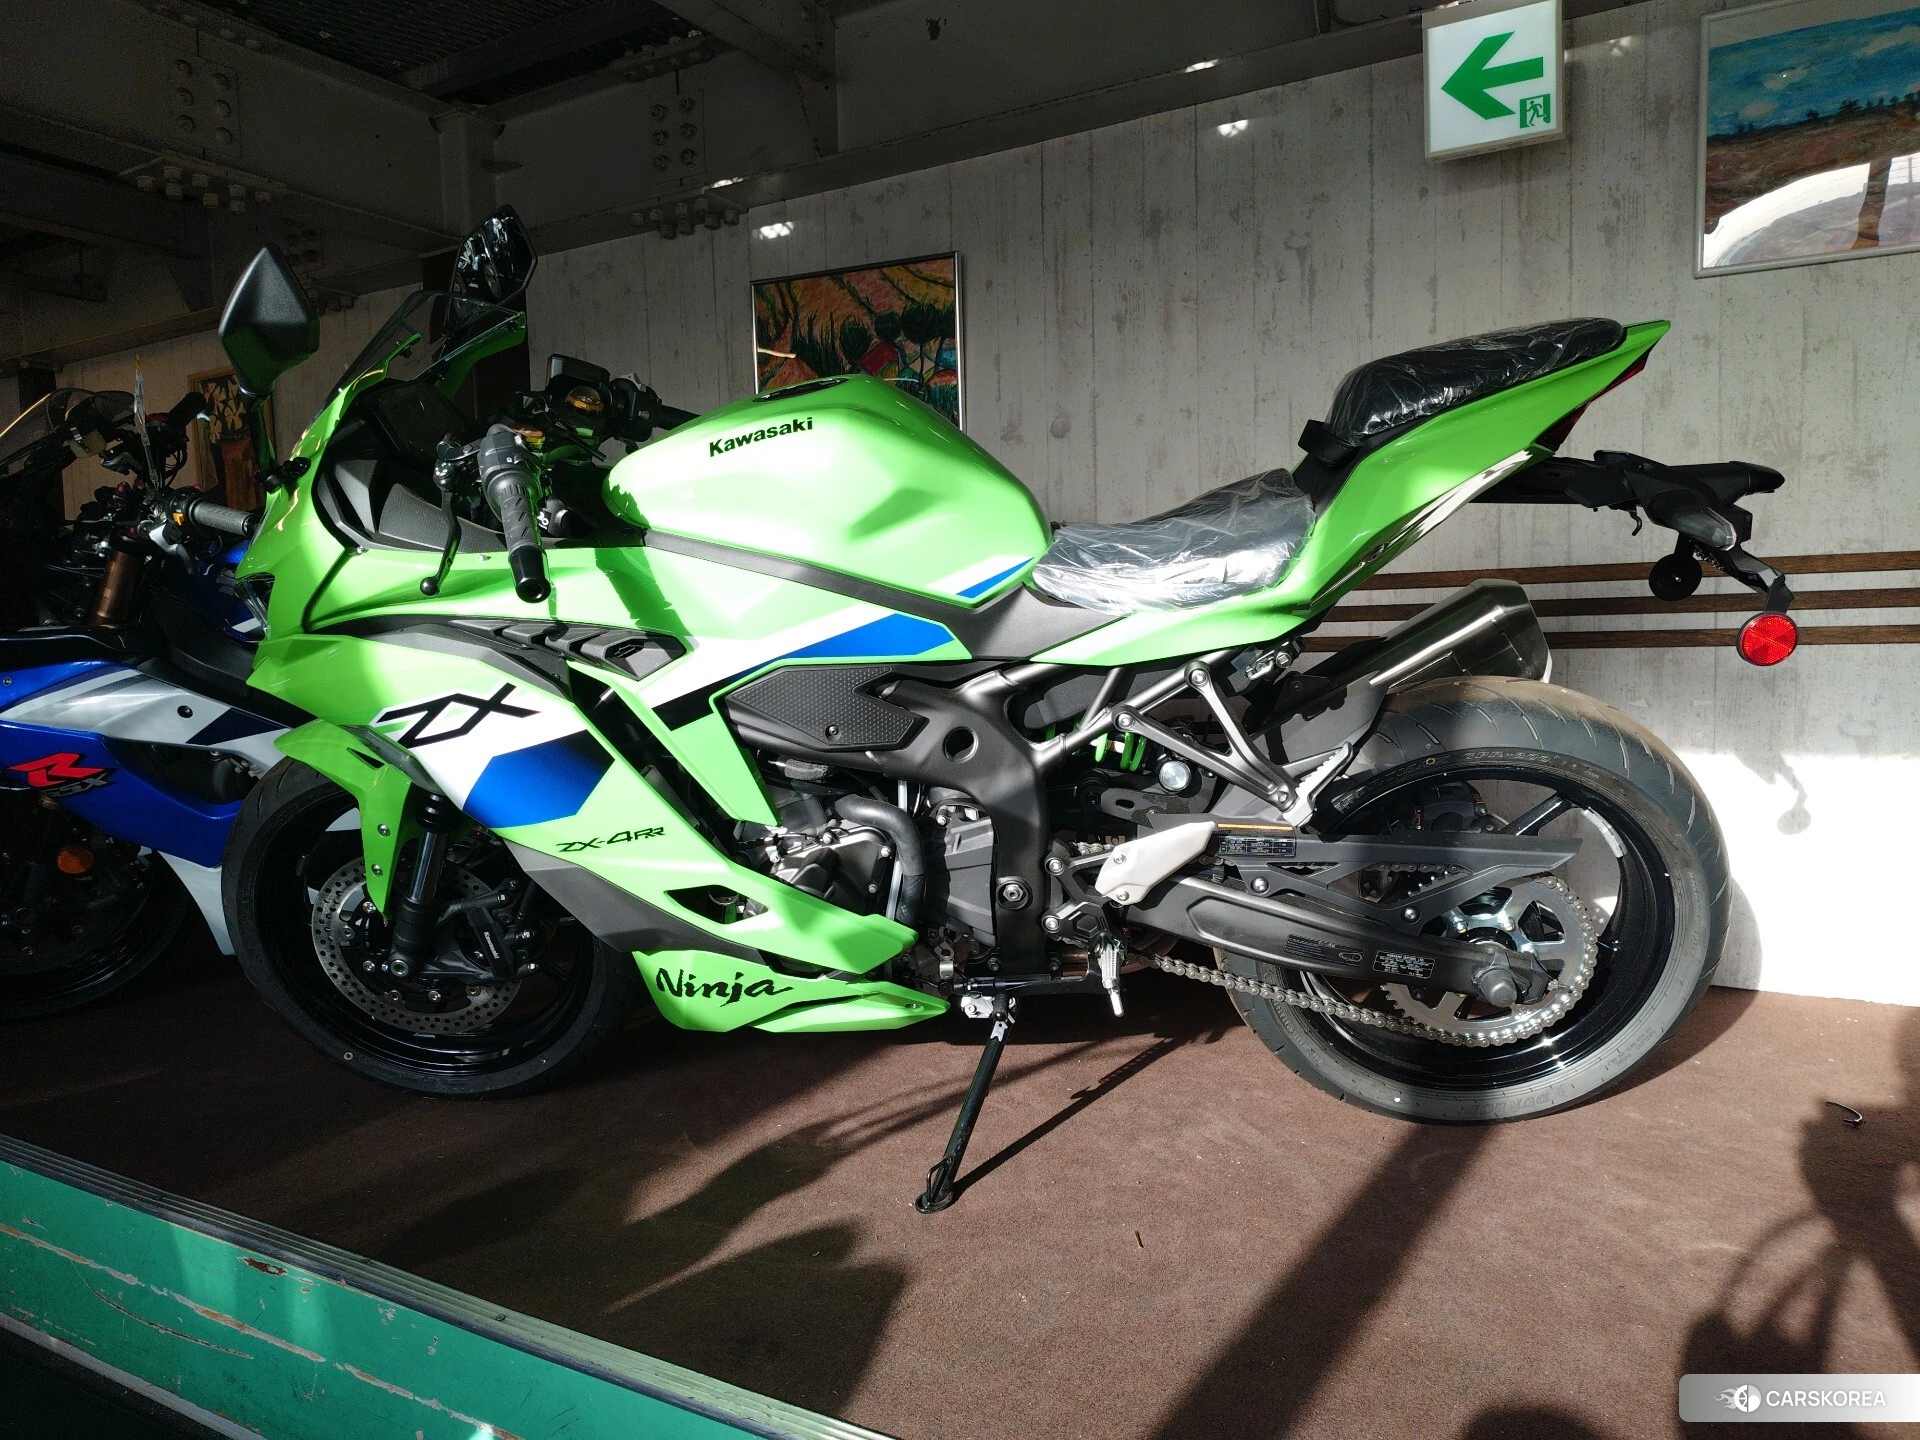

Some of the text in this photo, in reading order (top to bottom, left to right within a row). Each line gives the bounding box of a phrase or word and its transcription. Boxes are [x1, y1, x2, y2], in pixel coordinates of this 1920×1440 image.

[709, 416, 813, 457] Kawasaki
[375, 682, 542, 749] ZX
[555, 826, 666, 853] ZX-4RR
[483, 931, 501, 959] Kawasaki
[655, 967, 794, 1008] Ninja
